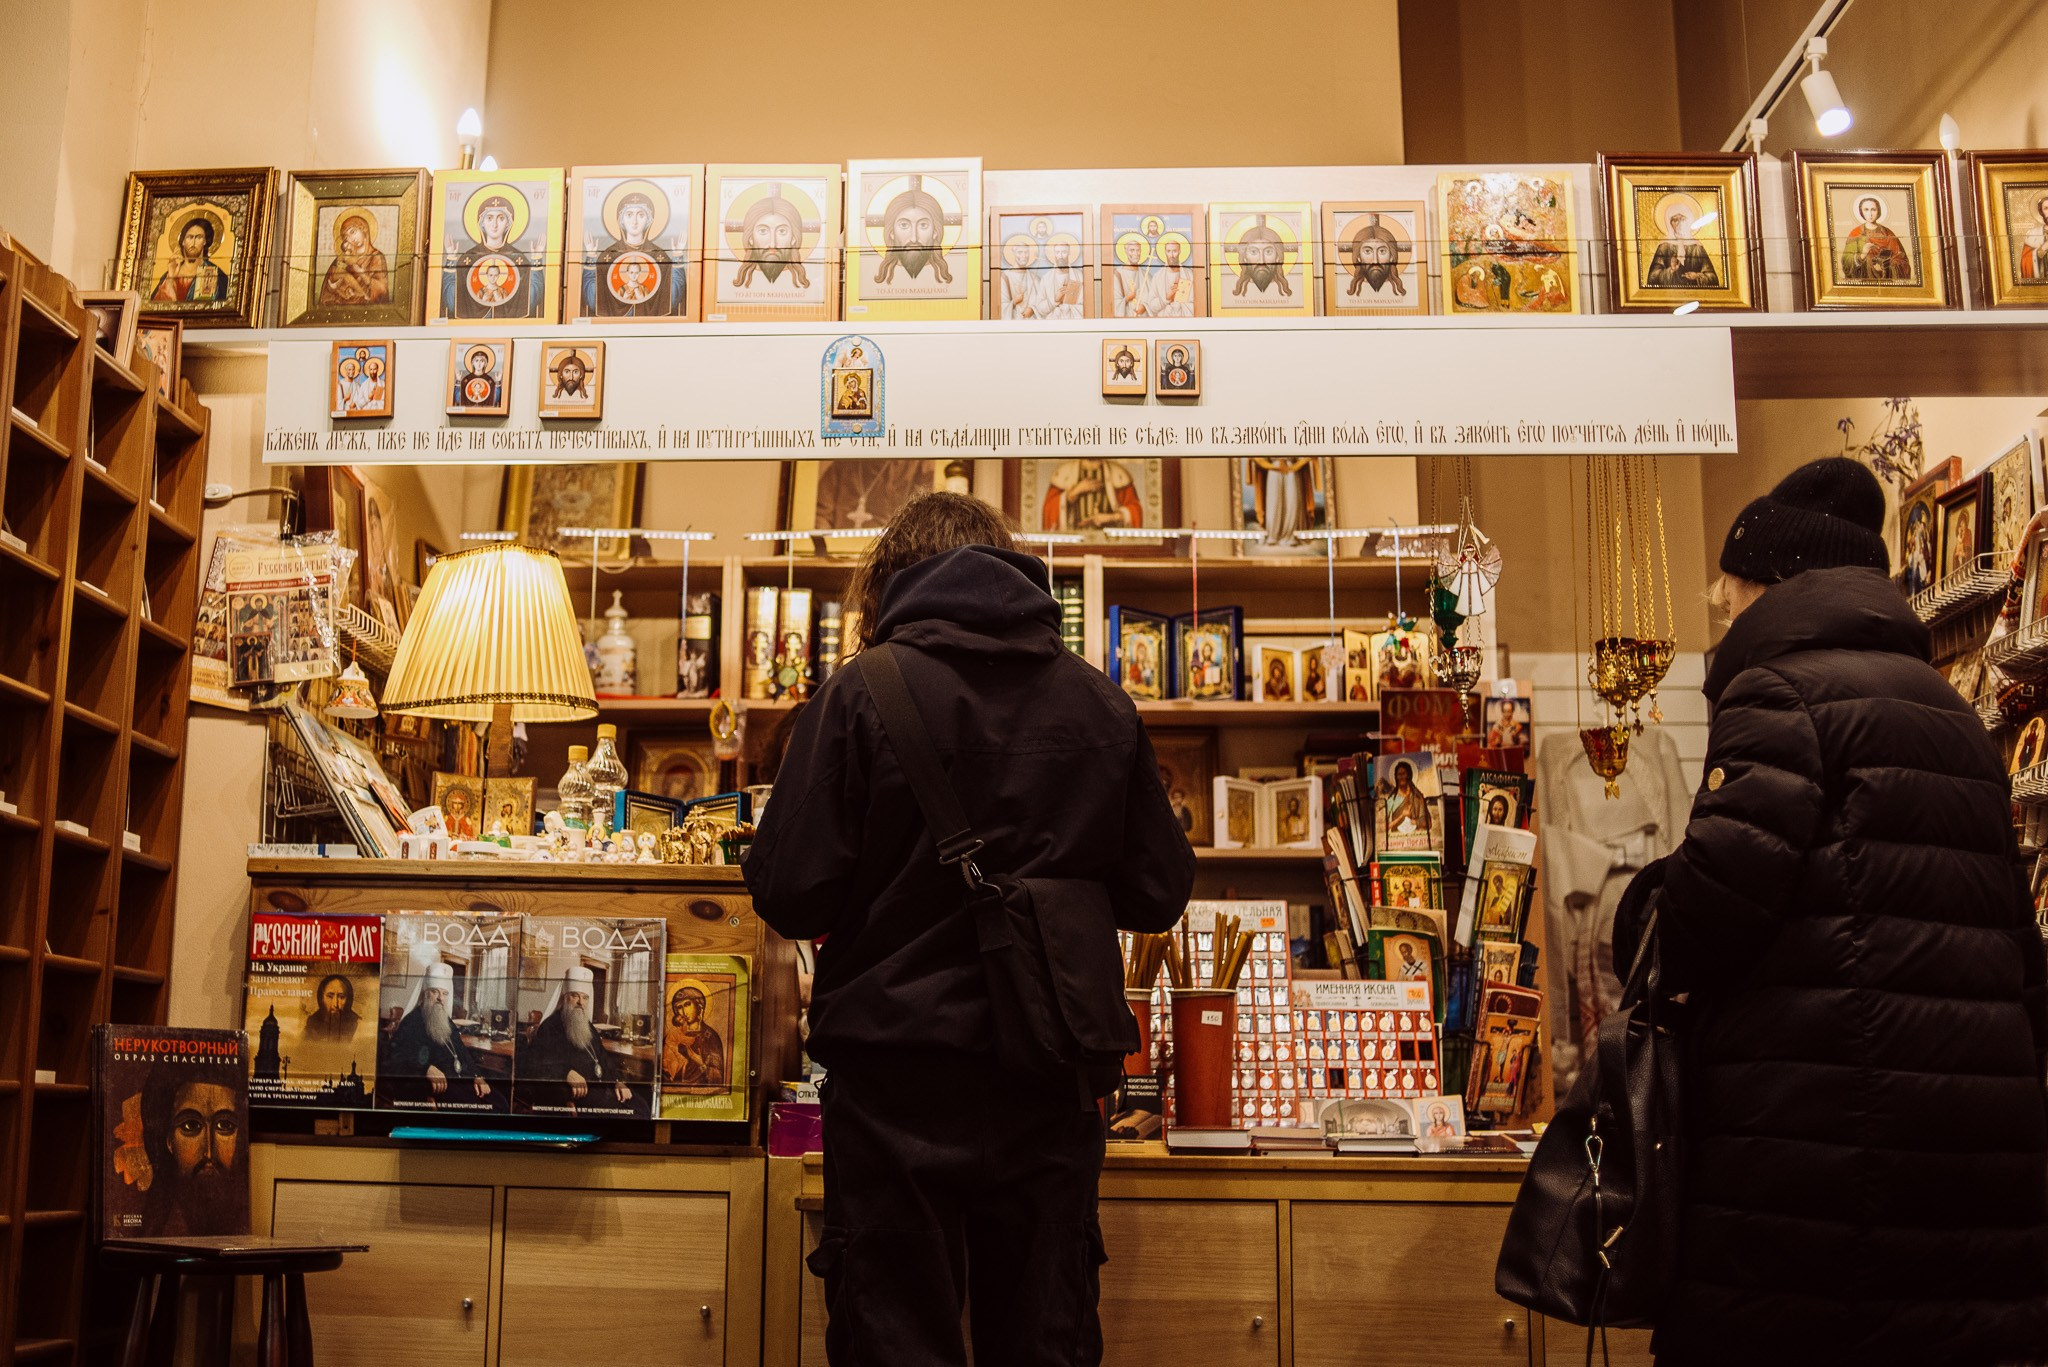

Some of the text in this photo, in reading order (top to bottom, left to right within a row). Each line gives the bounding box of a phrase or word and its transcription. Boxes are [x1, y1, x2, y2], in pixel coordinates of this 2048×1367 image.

[413, 431, 430, 450] НЕ
[469, 432, 485, 450] НА
[673, 430, 690, 449] НА
[905, 428, 923, 448] НА
[1109, 426, 1128, 446] НЕ
[1185, 426, 1203, 446] НО
[423, 922, 511, 947] ВОДА
[562, 926, 653, 951] ВОДА
[251, 961, 308, 975] На Украине
[249, 986, 313, 998] Православие
[1315, 983, 1397, 995] ИМЕННАЯ ИКОНА
[113, 1037, 239, 1056] НЕРУКОТВОРНЫЙ
[114, 1053, 238, 1065] ОБРАЗ СПАСИТЕЛЯ
